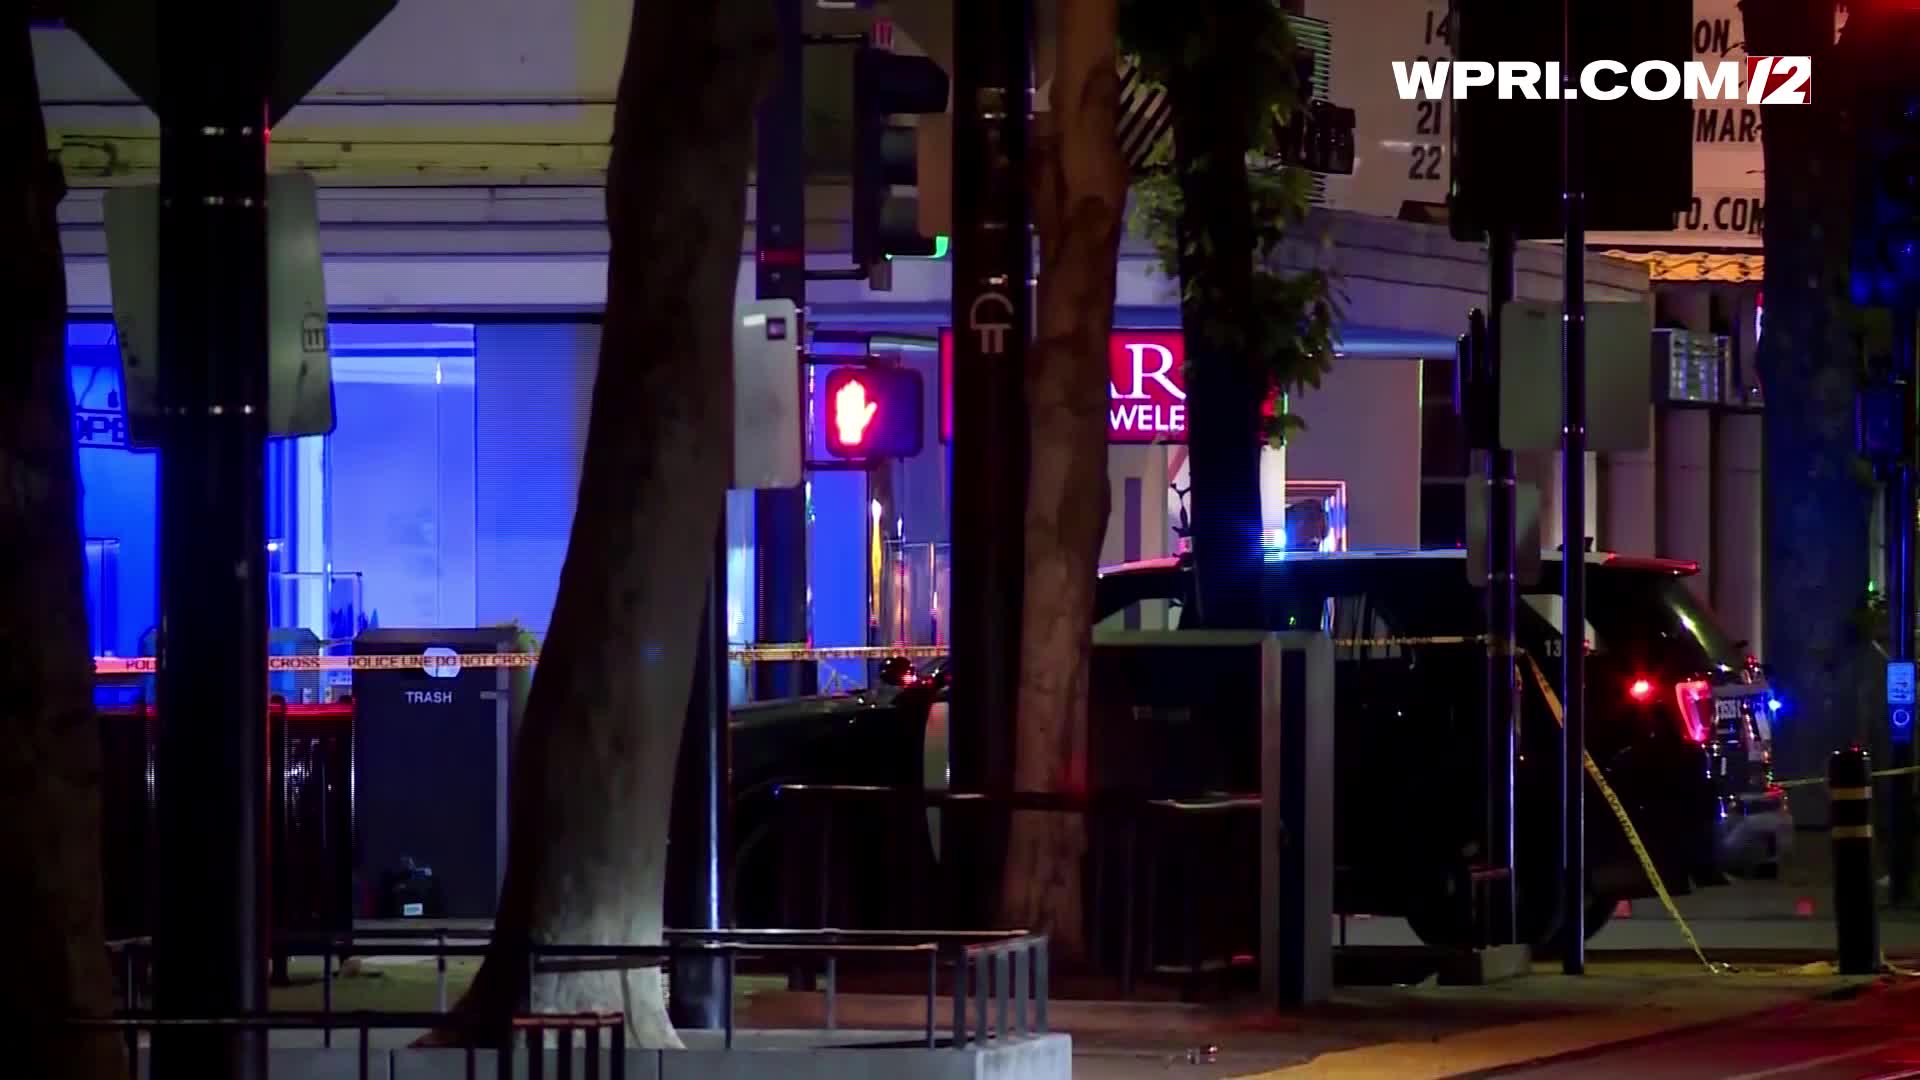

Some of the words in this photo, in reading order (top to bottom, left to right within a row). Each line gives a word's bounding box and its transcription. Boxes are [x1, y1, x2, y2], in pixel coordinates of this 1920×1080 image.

[1425, 11, 1450, 45] 14
[1416, 102, 1442, 135] 21
[1692, 108, 1757, 142] MAR
[1409, 146, 1441, 180] 22
[1110, 343, 1187, 400] R
[270, 656, 320, 668] CROSS
[348, 656, 398, 668] POLICE
[402, 655, 431, 666] LINE
[436, 655, 456, 665] DO
[460, 655, 489, 665] NOT
[405, 690, 453, 704] TRASH
